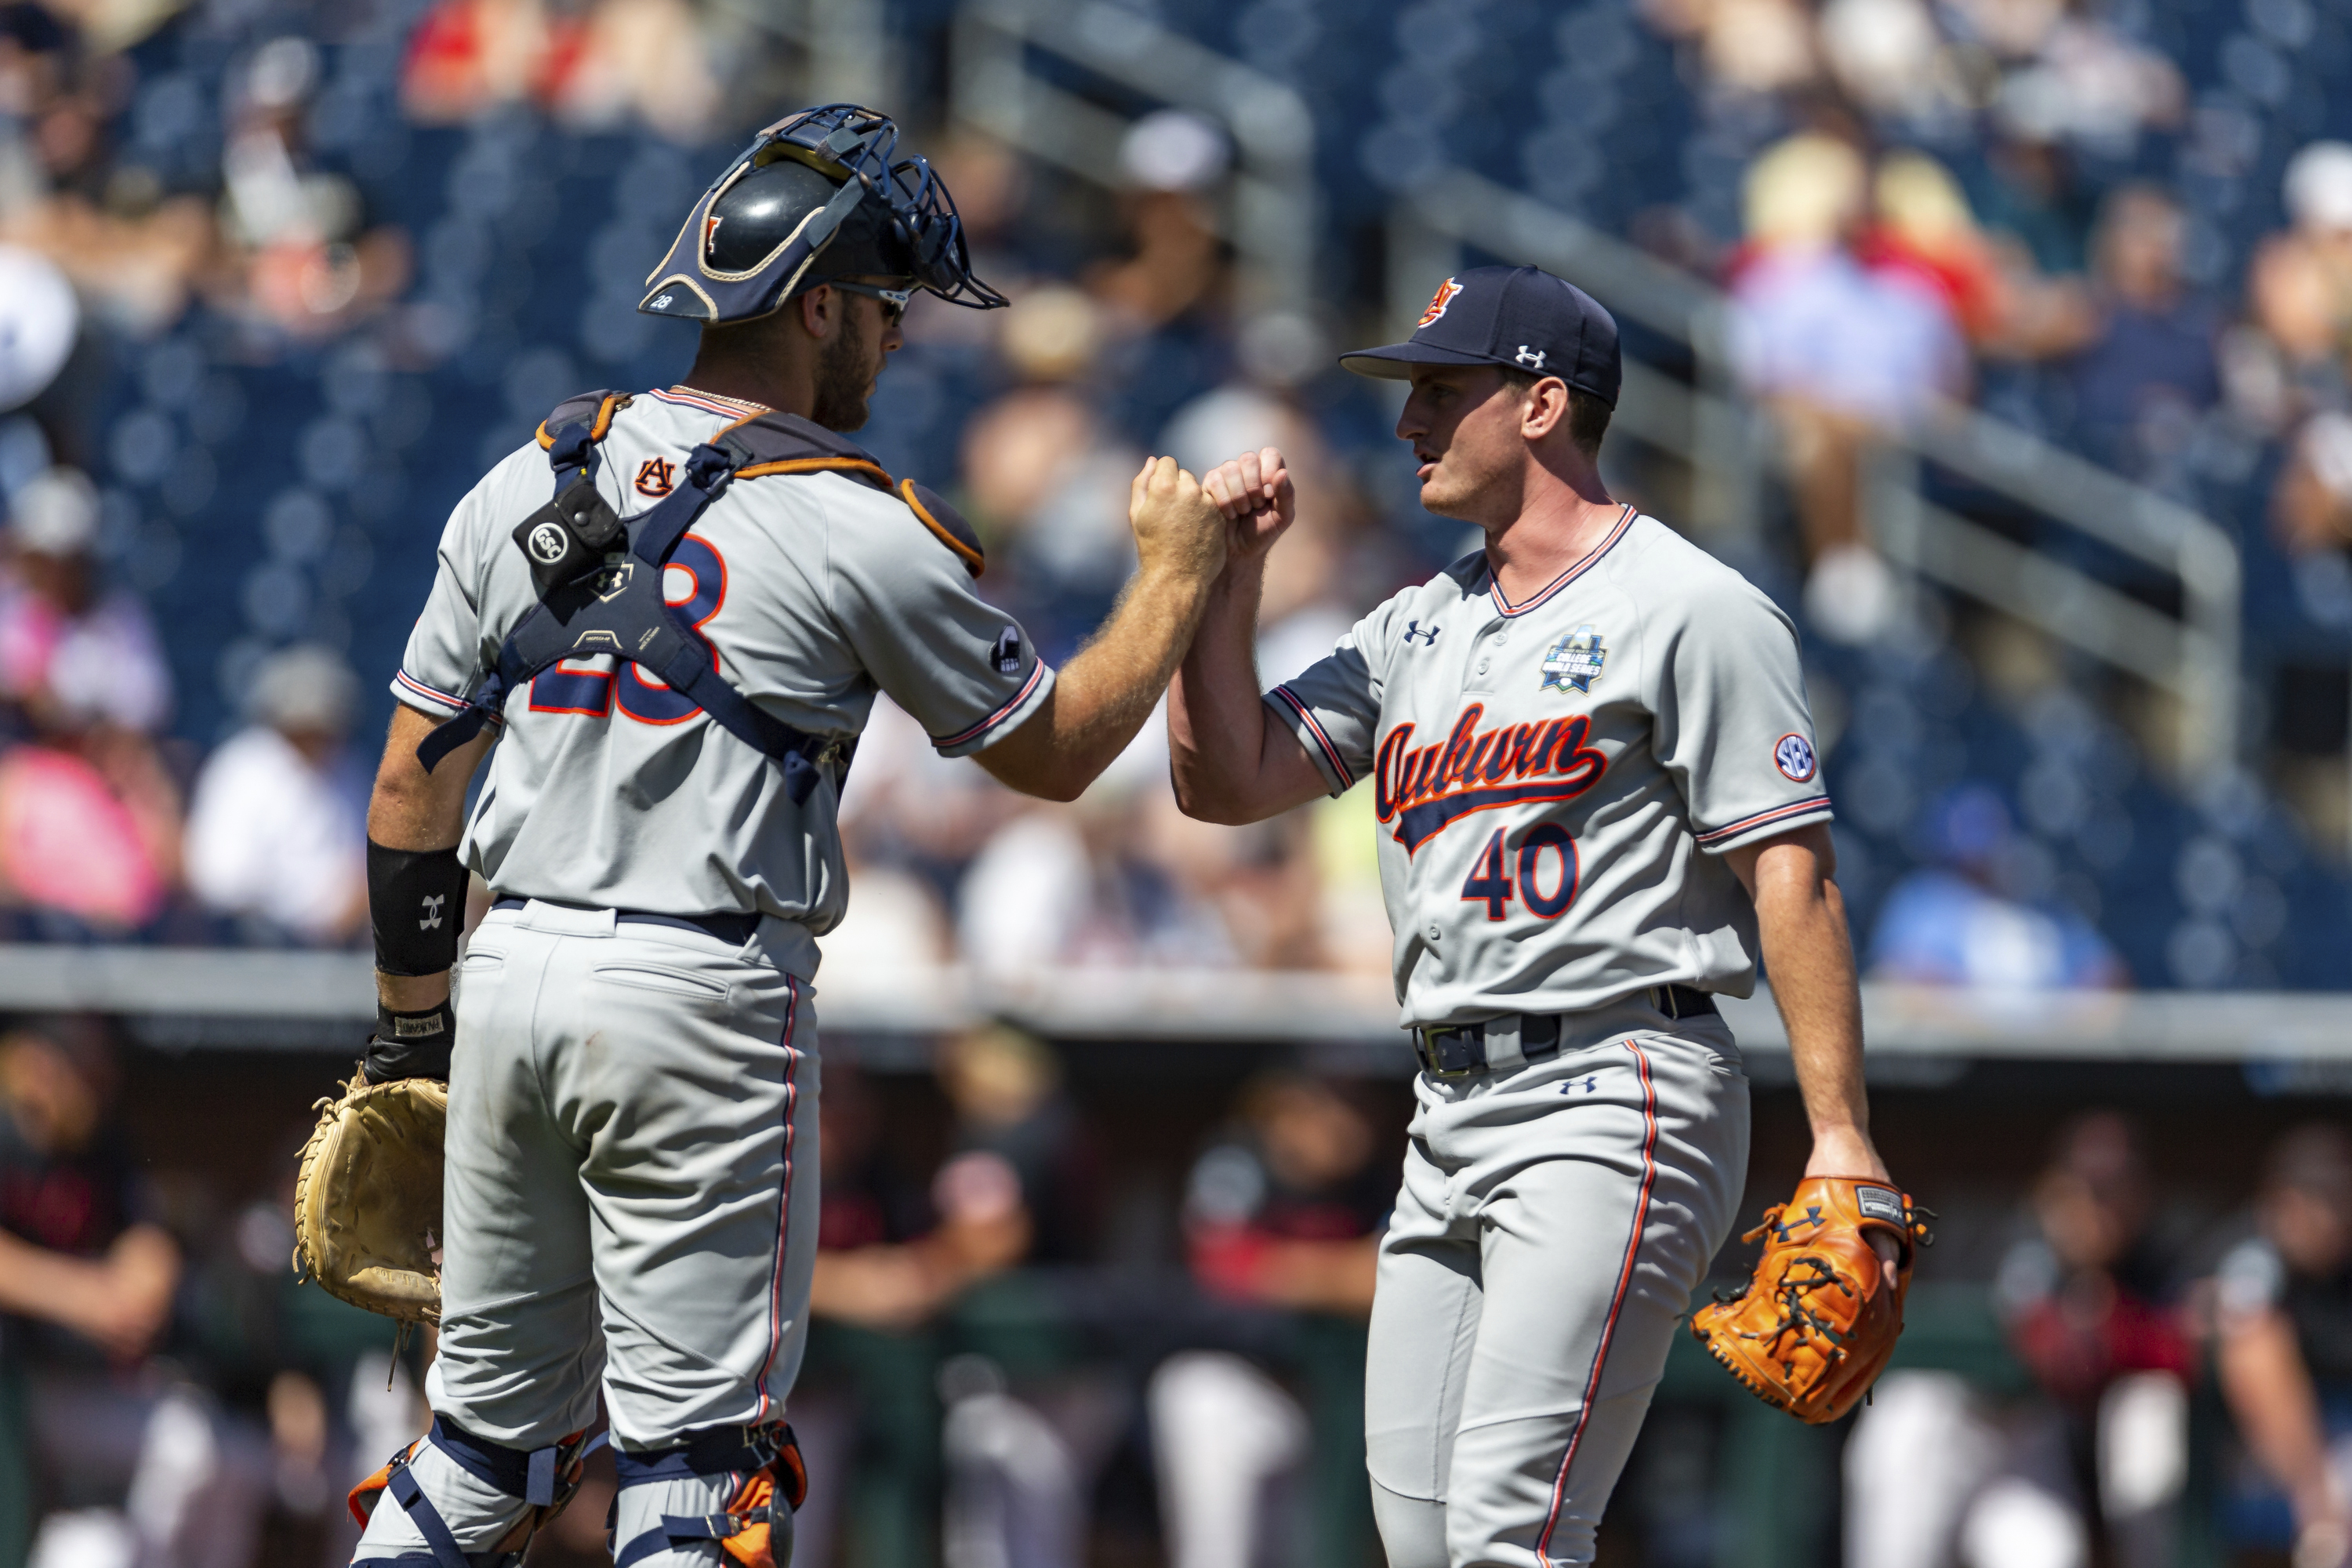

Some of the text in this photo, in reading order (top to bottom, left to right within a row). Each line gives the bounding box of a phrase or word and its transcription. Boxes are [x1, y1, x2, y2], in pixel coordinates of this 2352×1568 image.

[650, 295, 673, 310] 28
[535, 528, 562, 559] GSC
[1542, 662, 1601, 676] WORLD SERIES
[1556, 652, 1592, 664] COLLEGE
[1375, 702, 1606, 827] Auburn
[1777, 735, 1813, 778] SEC
[1461, 822, 1579, 921] 40
